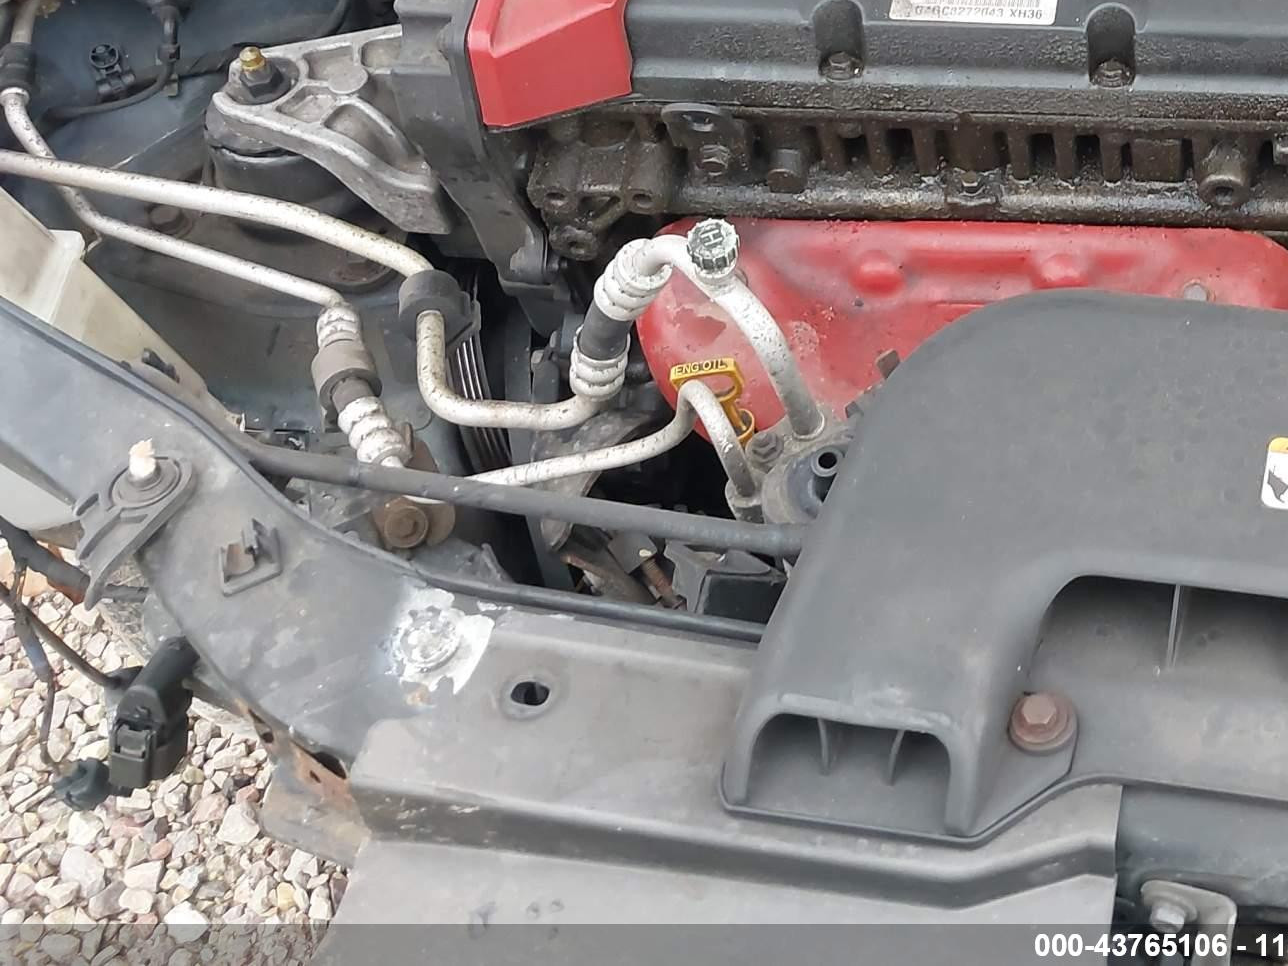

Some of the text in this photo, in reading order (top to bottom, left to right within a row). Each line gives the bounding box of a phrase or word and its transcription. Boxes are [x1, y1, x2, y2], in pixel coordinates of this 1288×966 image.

[1009, 8, 1042, 20] XH36
[700, 229, 723, 247] H
[675, 358, 728, 376] ENG OIL
